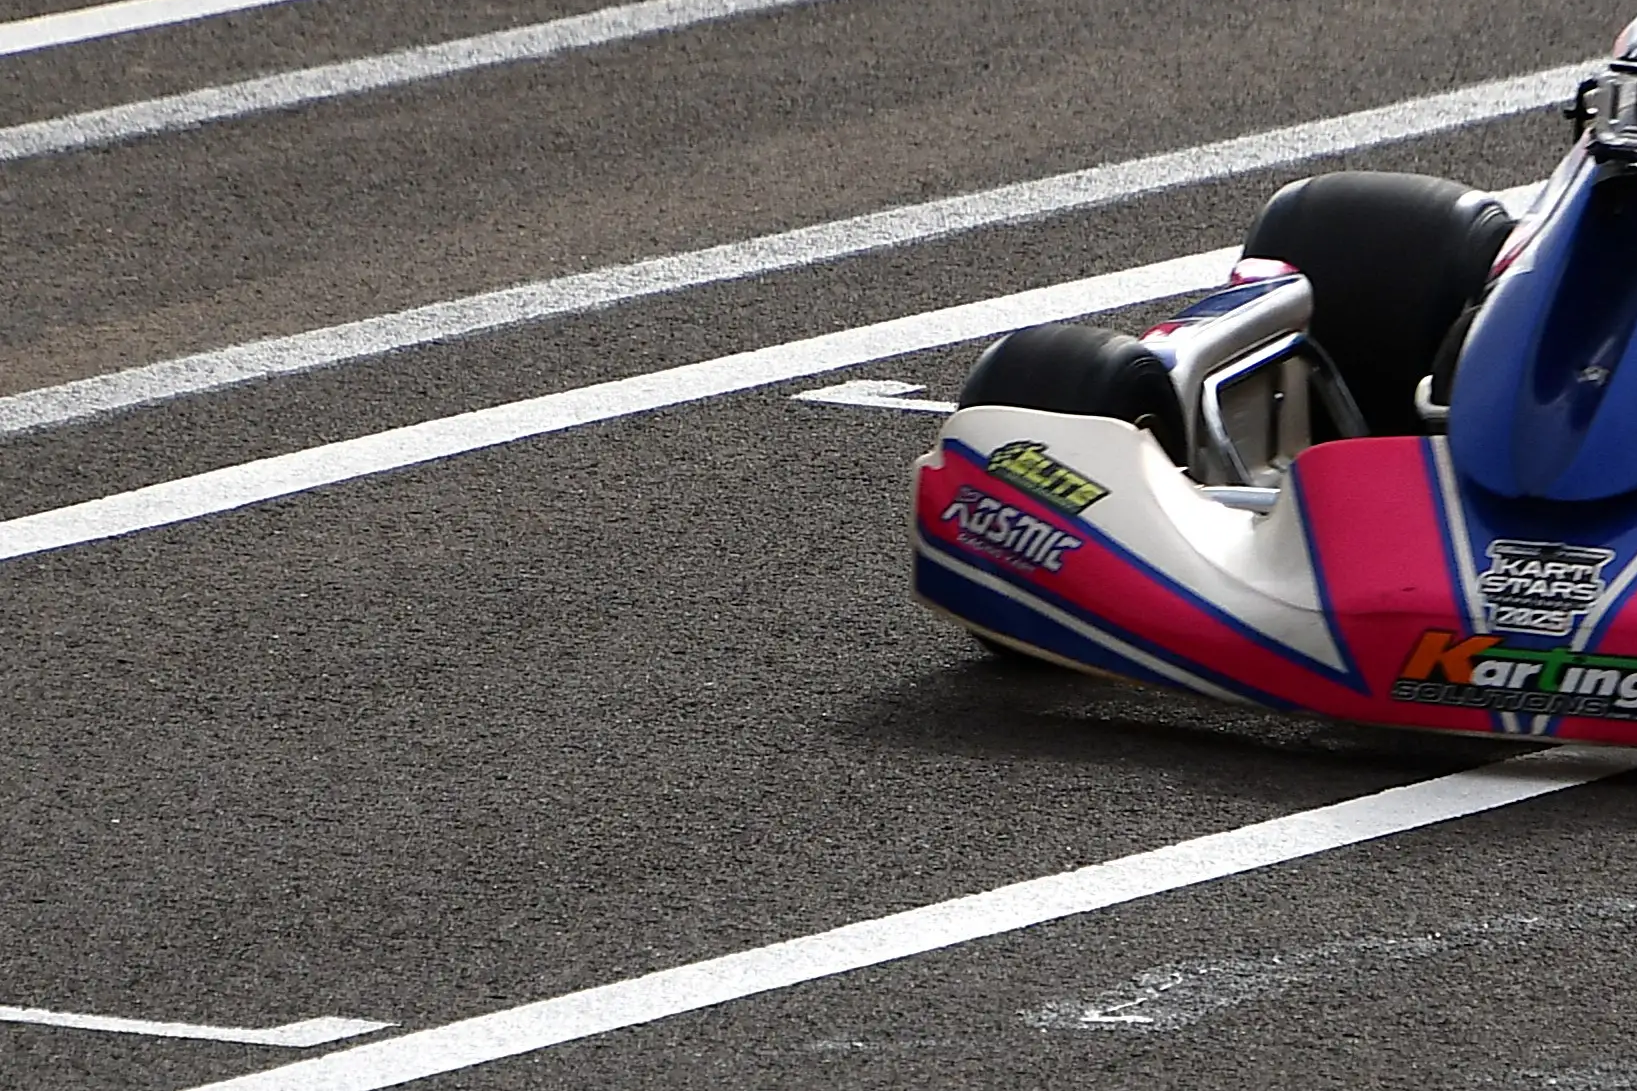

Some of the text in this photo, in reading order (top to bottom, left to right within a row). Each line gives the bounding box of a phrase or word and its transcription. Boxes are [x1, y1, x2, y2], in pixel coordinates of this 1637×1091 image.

[1498, 558, 1594, 581] KART
[1481, 575, 1598, 601] STARS
[1496, 606, 1569, 630] 2025
[1391, 680, 1609, 716] SOLUTIONS
